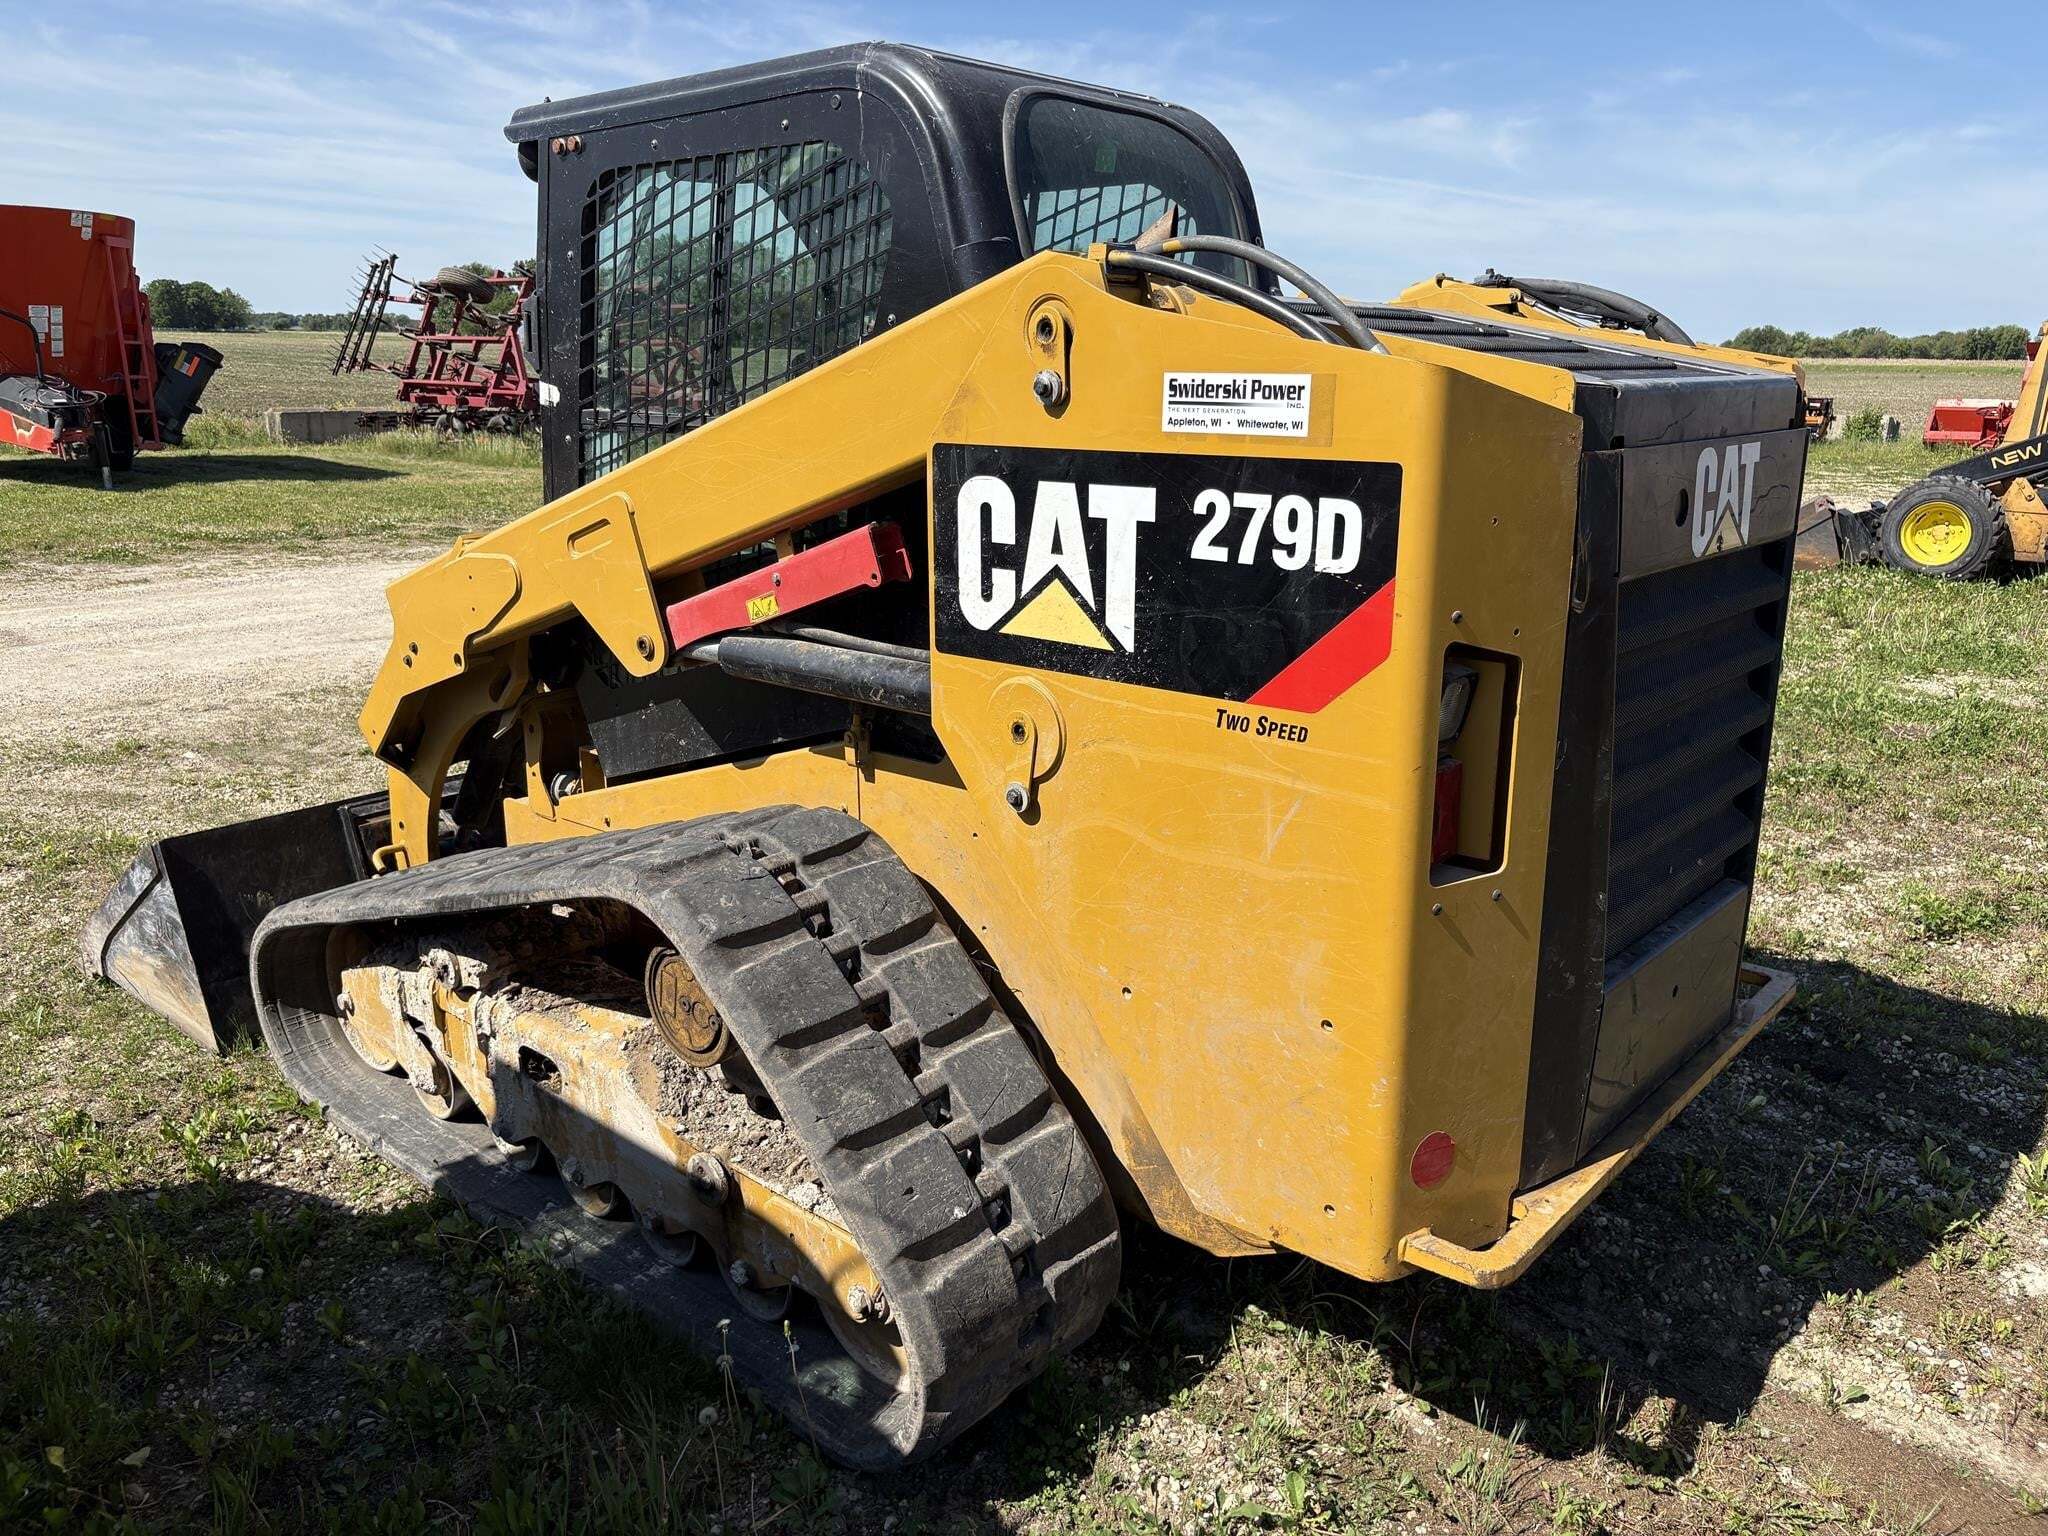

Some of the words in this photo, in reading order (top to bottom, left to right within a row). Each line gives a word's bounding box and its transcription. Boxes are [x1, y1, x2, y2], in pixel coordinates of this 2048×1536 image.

[1168, 378, 1247, 399] Swiderski
[1250, 379, 1306, 401] Power
[1202, 407, 1246, 415] GENERATION
[1167, 417, 1208, 429] Appleton,
[1210, 418, 1222, 427] WI
[1237, 419, 1289, 431] Whitewater,
[1291, 421, 1304, 430] WI
[1990, 442, 2042, 470] NEW
[1691, 441, 1761, 558] CAT
[957, 475, 1157, 653] CAT
[1190, 488, 1363, 575] 279D
